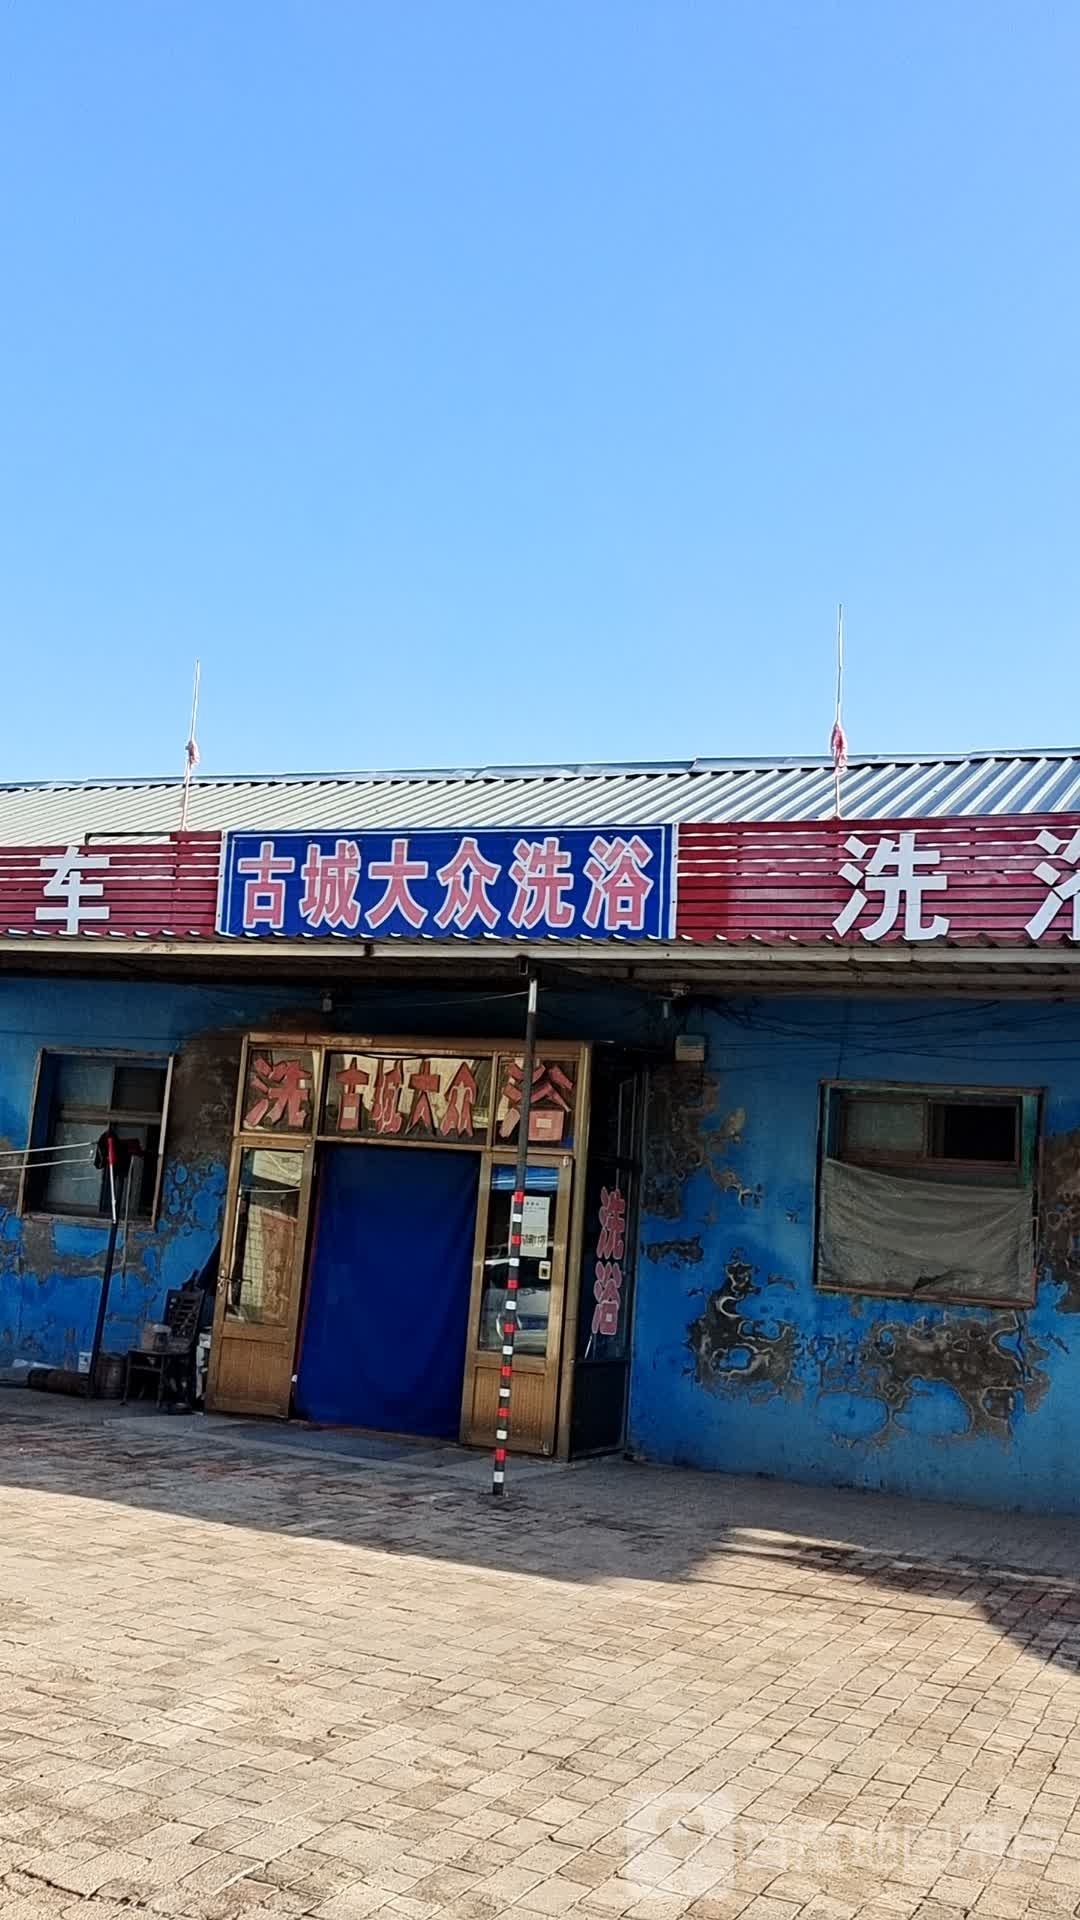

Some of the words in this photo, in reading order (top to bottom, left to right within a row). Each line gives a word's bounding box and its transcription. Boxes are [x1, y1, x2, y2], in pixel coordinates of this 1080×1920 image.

[35, 846, 110, 933] 车
[237, 835, 654, 931] 古城大众洗浴
[244, 1057, 312, 1128] 洗
[336, 1056, 477, 1137] 古城大众
[499, 1062, 574, 1142] 浴
[592, 1186, 626, 1336] 洗浴
